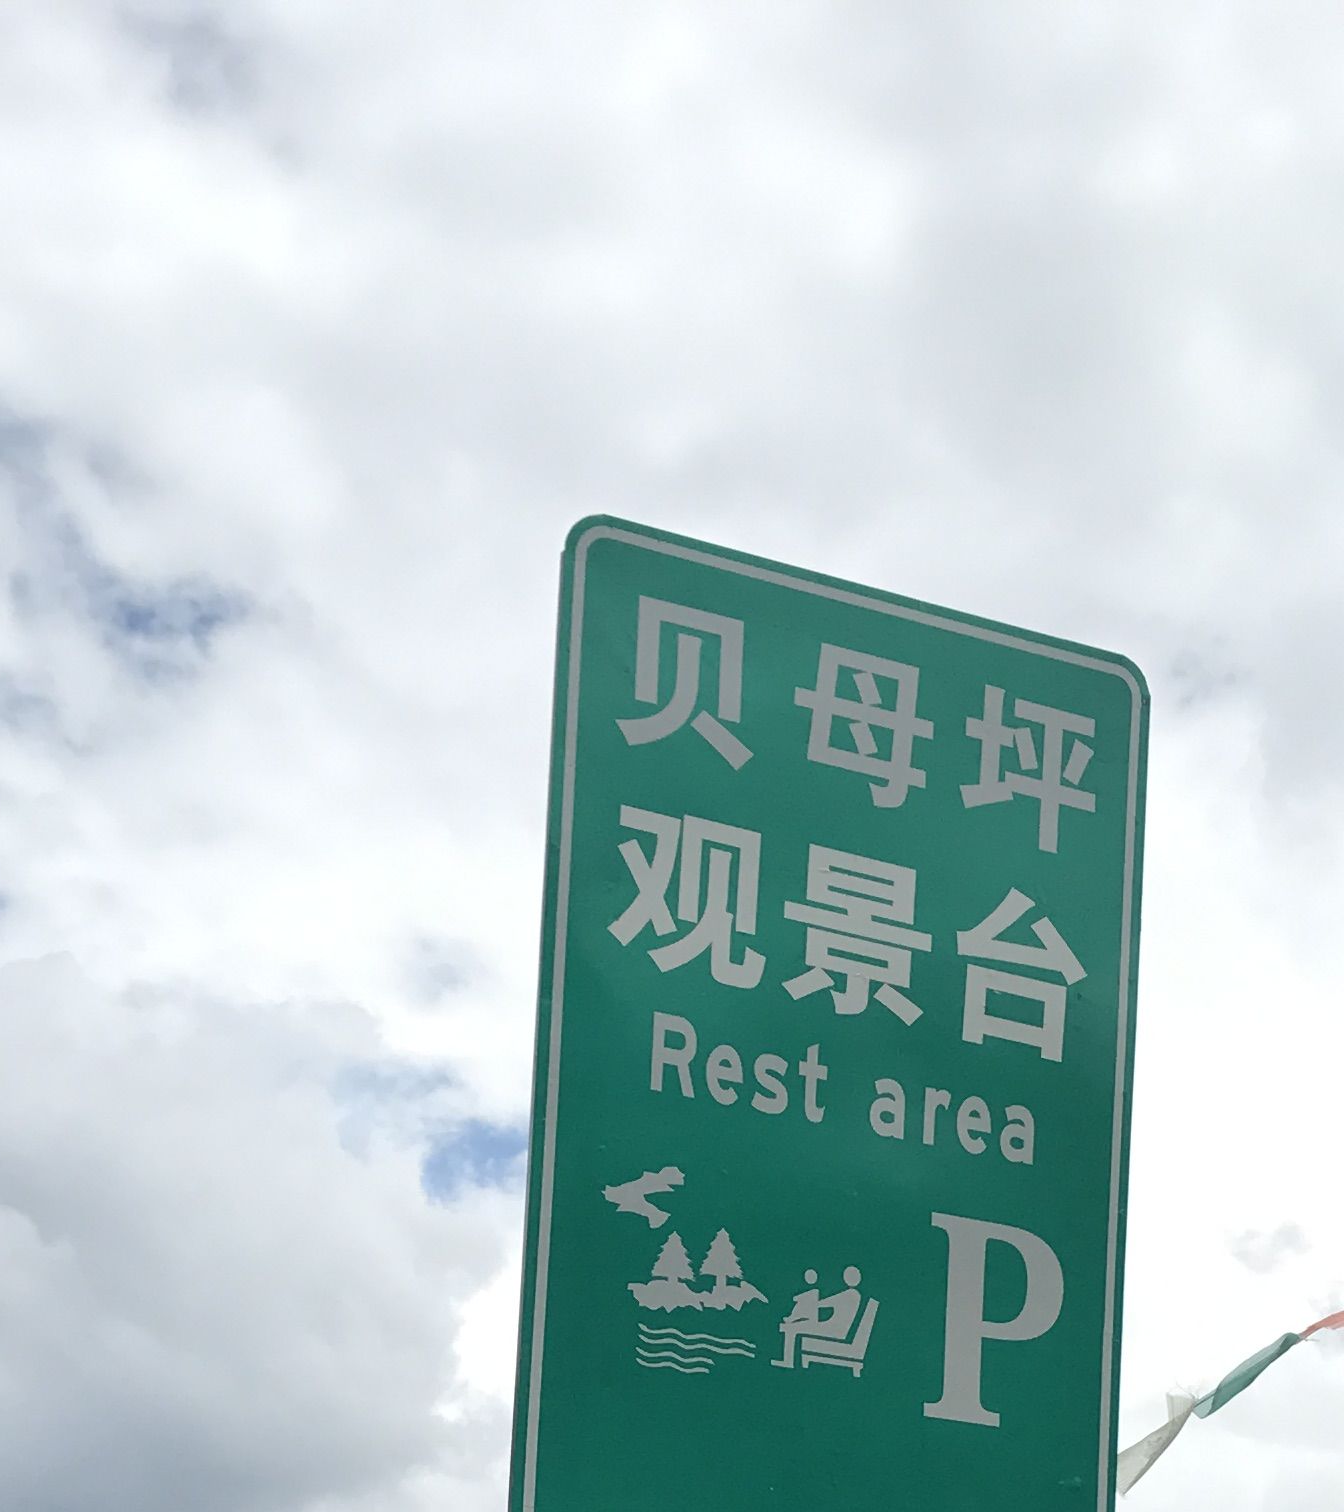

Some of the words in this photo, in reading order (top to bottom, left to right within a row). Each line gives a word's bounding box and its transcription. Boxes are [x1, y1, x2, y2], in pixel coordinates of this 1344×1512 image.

[615, 594, 1096, 853] 贝母坪
[607, 804, 1088, 1063] 观景台
[650, 1011, 829, 1123] Rest
[869, 1077, 1035, 1165] area
[923, 1211, 1064, 1428] P
